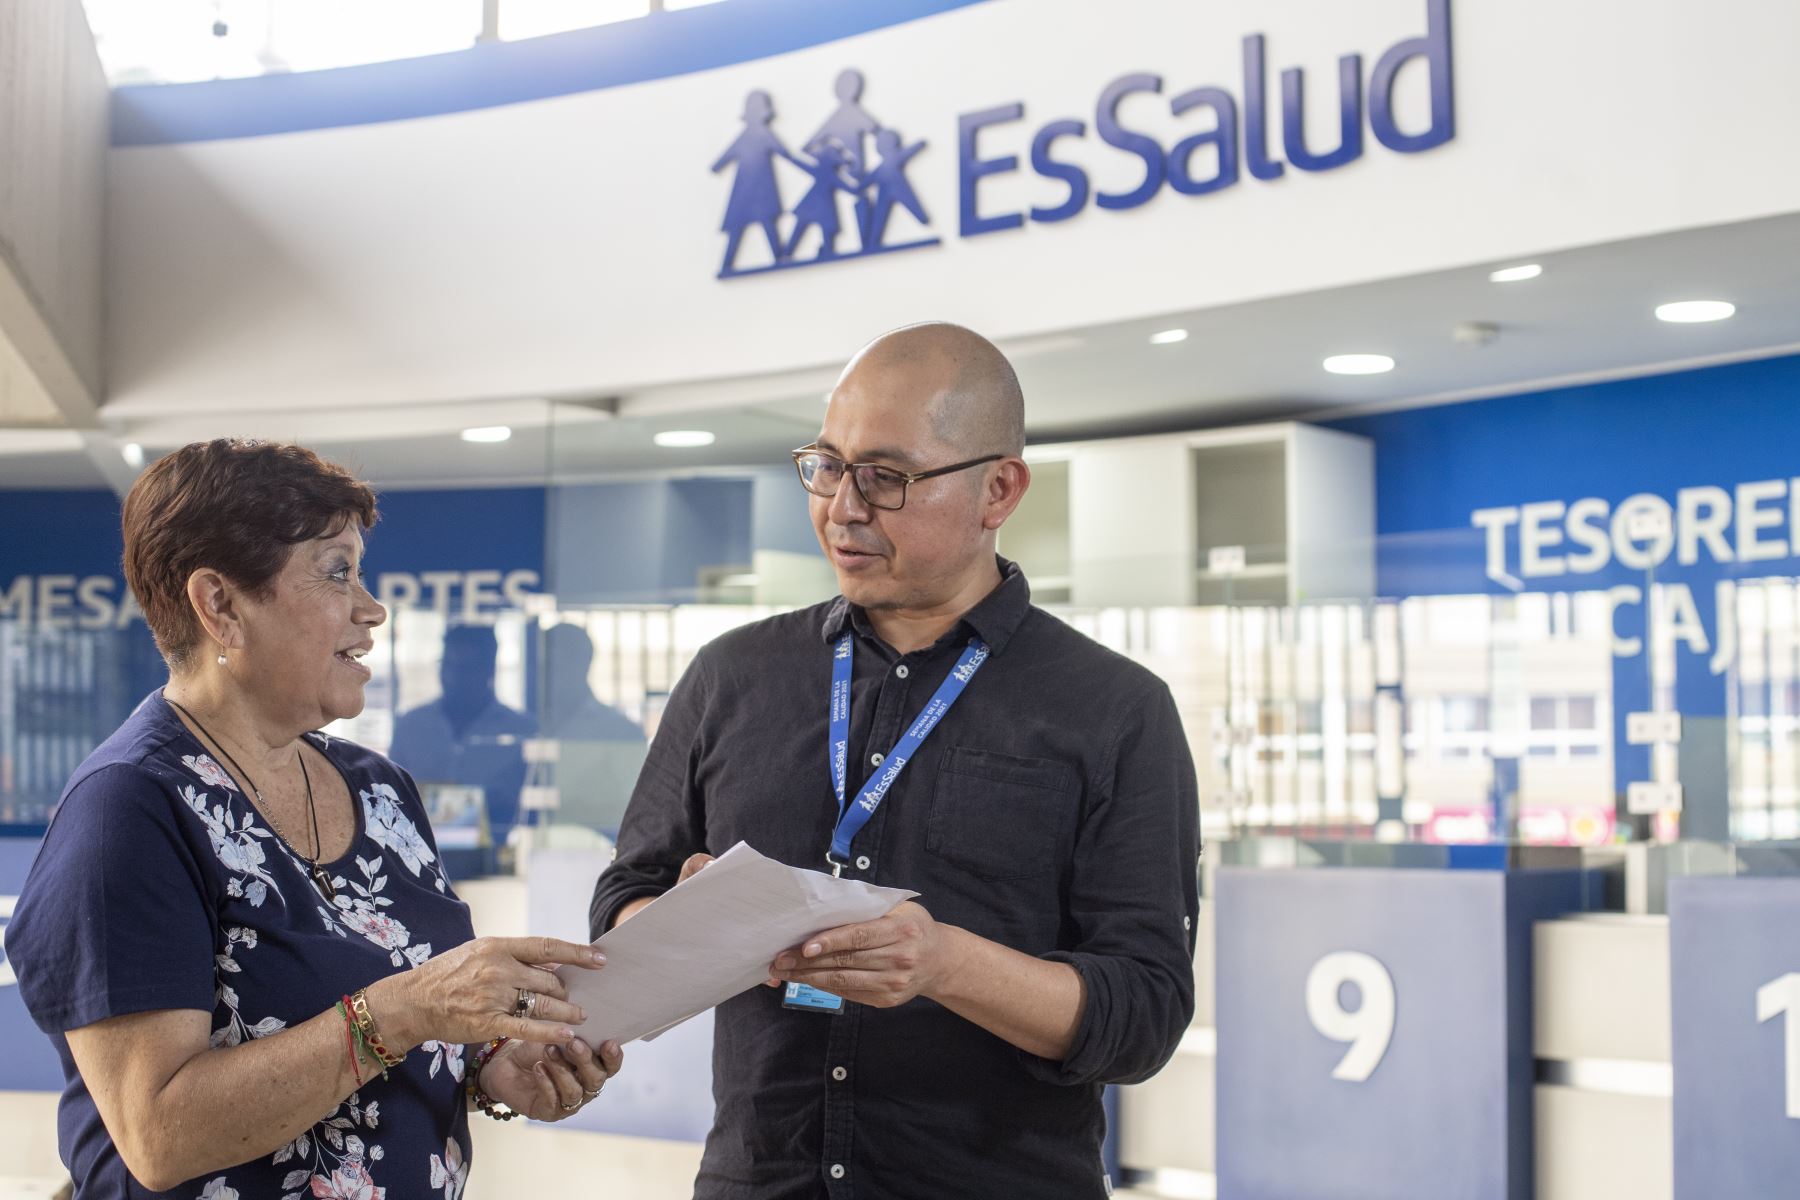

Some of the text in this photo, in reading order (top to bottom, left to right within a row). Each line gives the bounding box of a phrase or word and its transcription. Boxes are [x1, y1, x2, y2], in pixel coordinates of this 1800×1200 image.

[957, 0, 1457, 238] EsSalud
[378, 568, 541, 628] RTES
[1608, 579, 1738, 676] CAJ
[910, 699, 942, 737] SEMANA DE LA
[917, 716, 938, 739] CALIDAD
[835, 740, 846, 779] EsSalud
[874, 756, 906, 794] EsSalud
[1305, 951, 1396, 1083] 9
